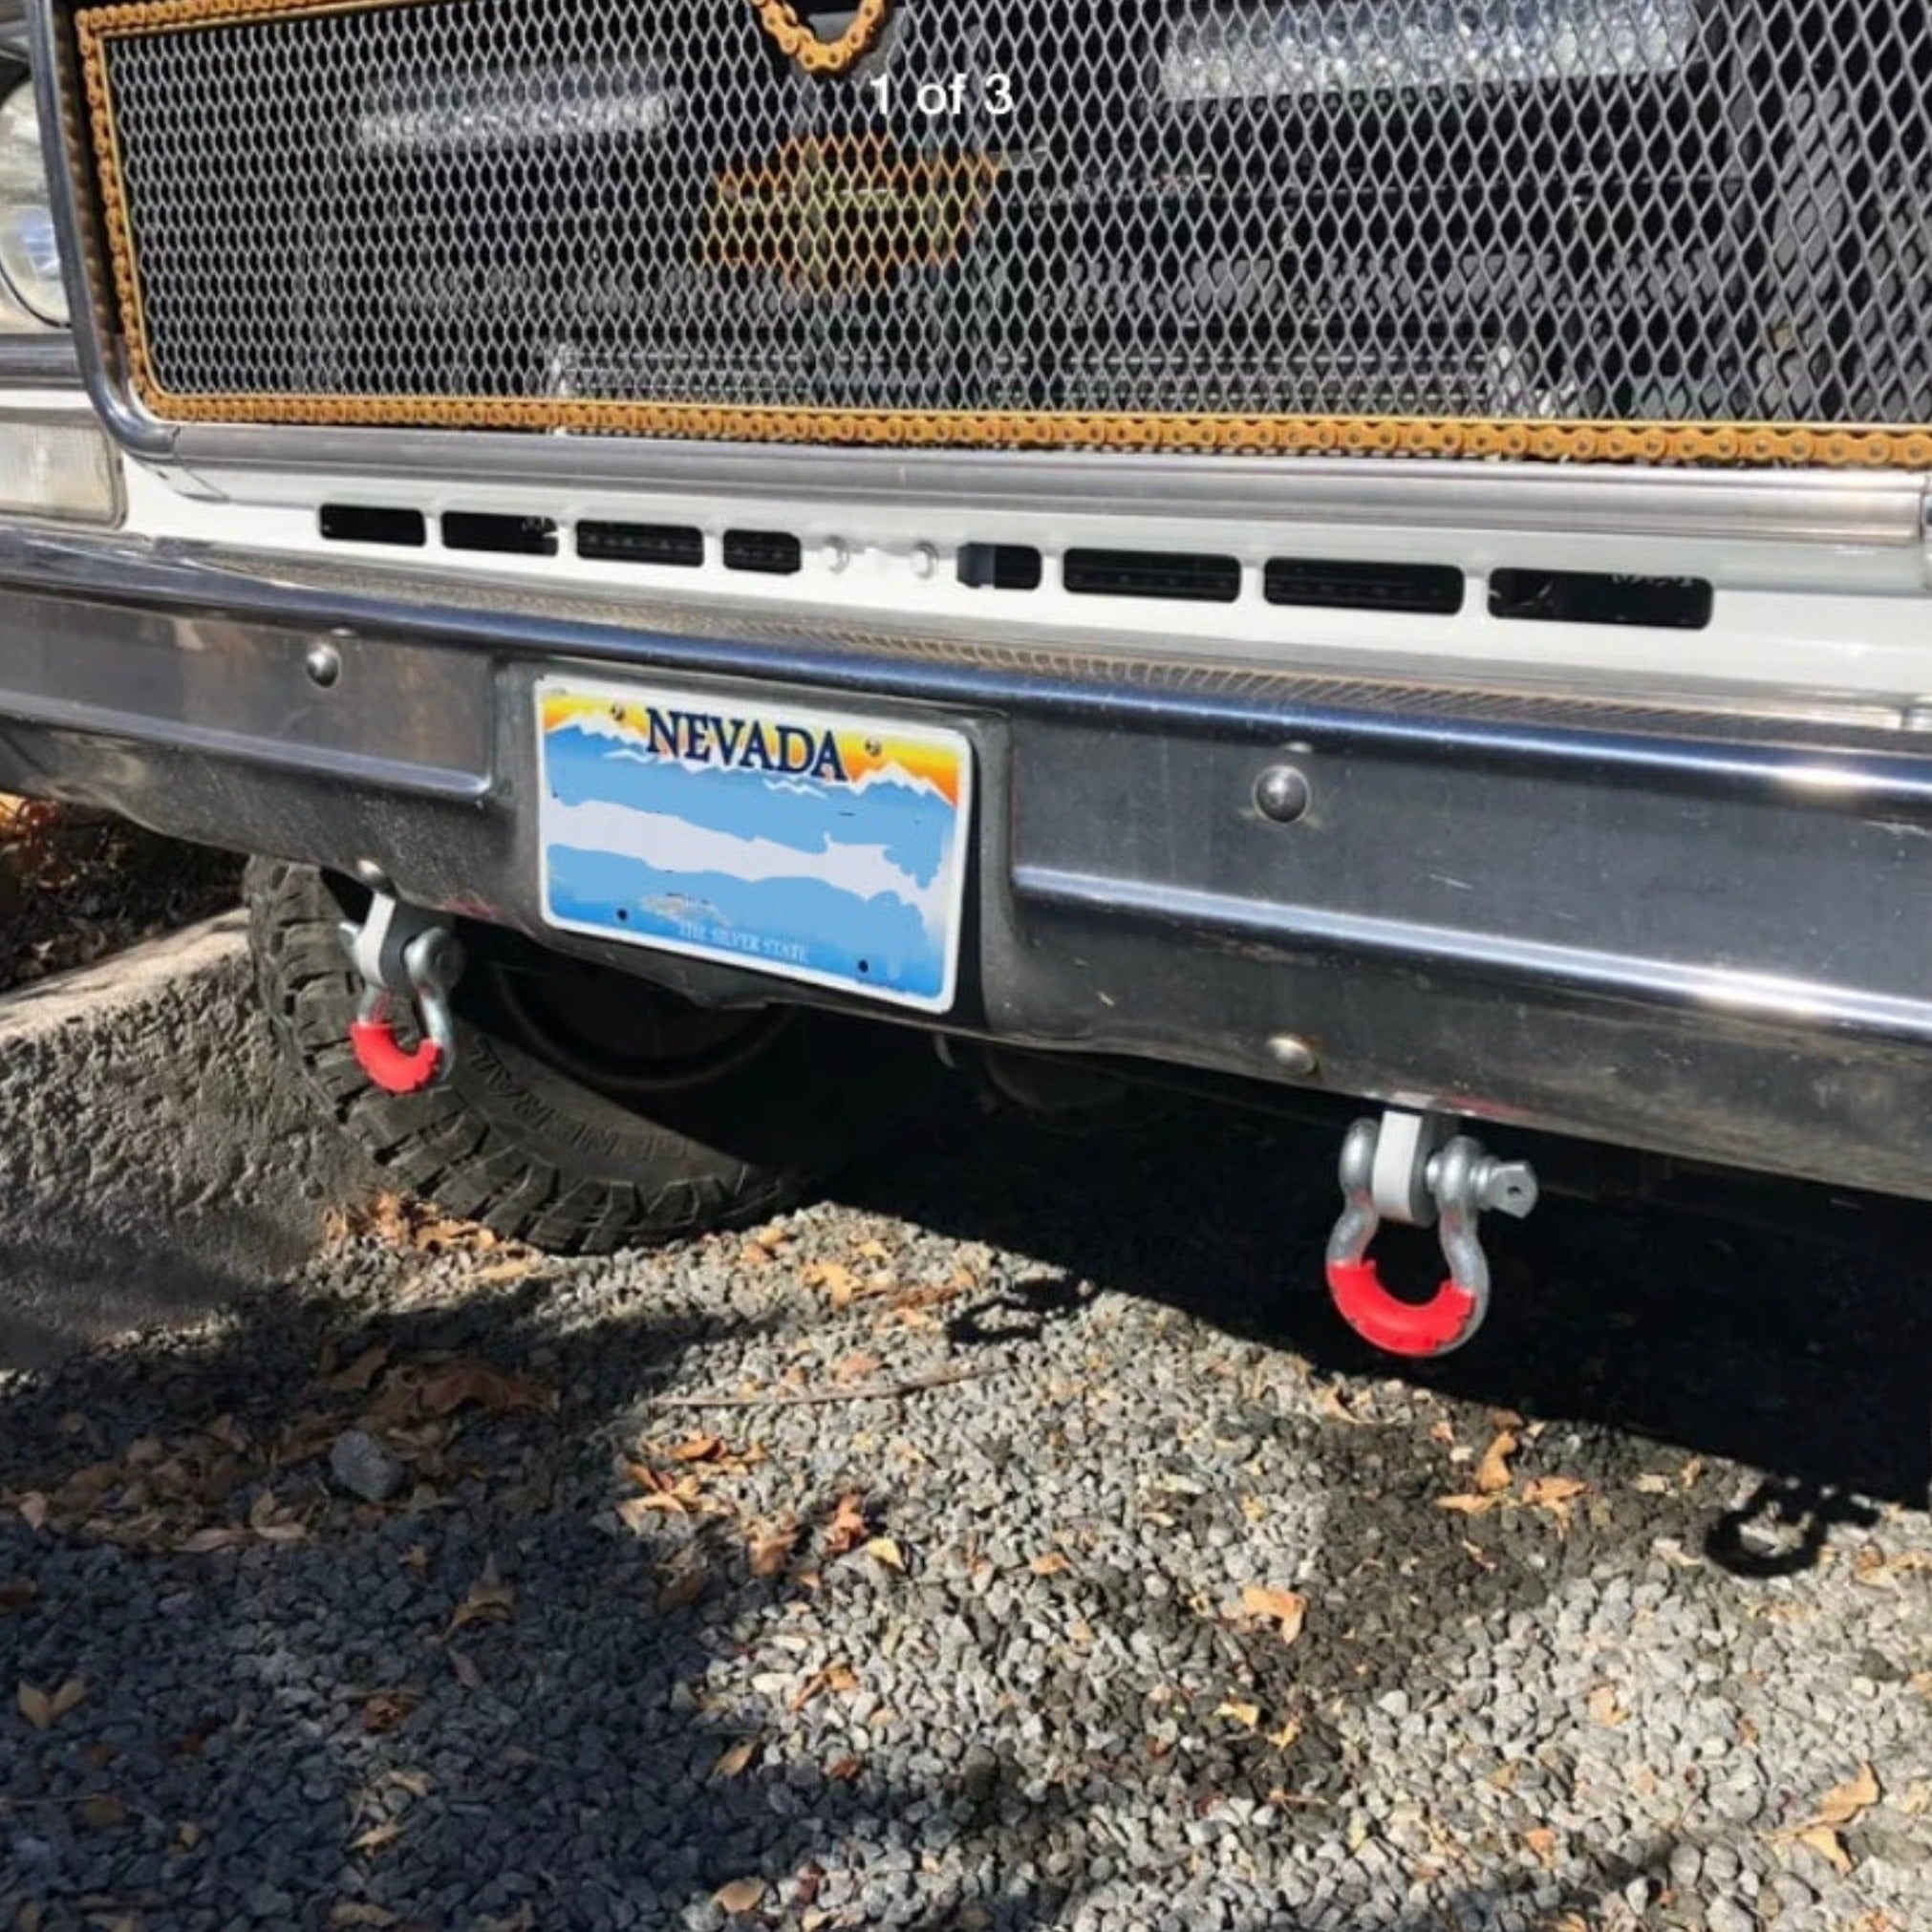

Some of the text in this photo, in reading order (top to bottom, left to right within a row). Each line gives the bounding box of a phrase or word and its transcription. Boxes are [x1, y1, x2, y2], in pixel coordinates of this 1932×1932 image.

[645, 707, 848, 782] NEVADA
[679, 920, 808, 964] THE SILVER STATE
